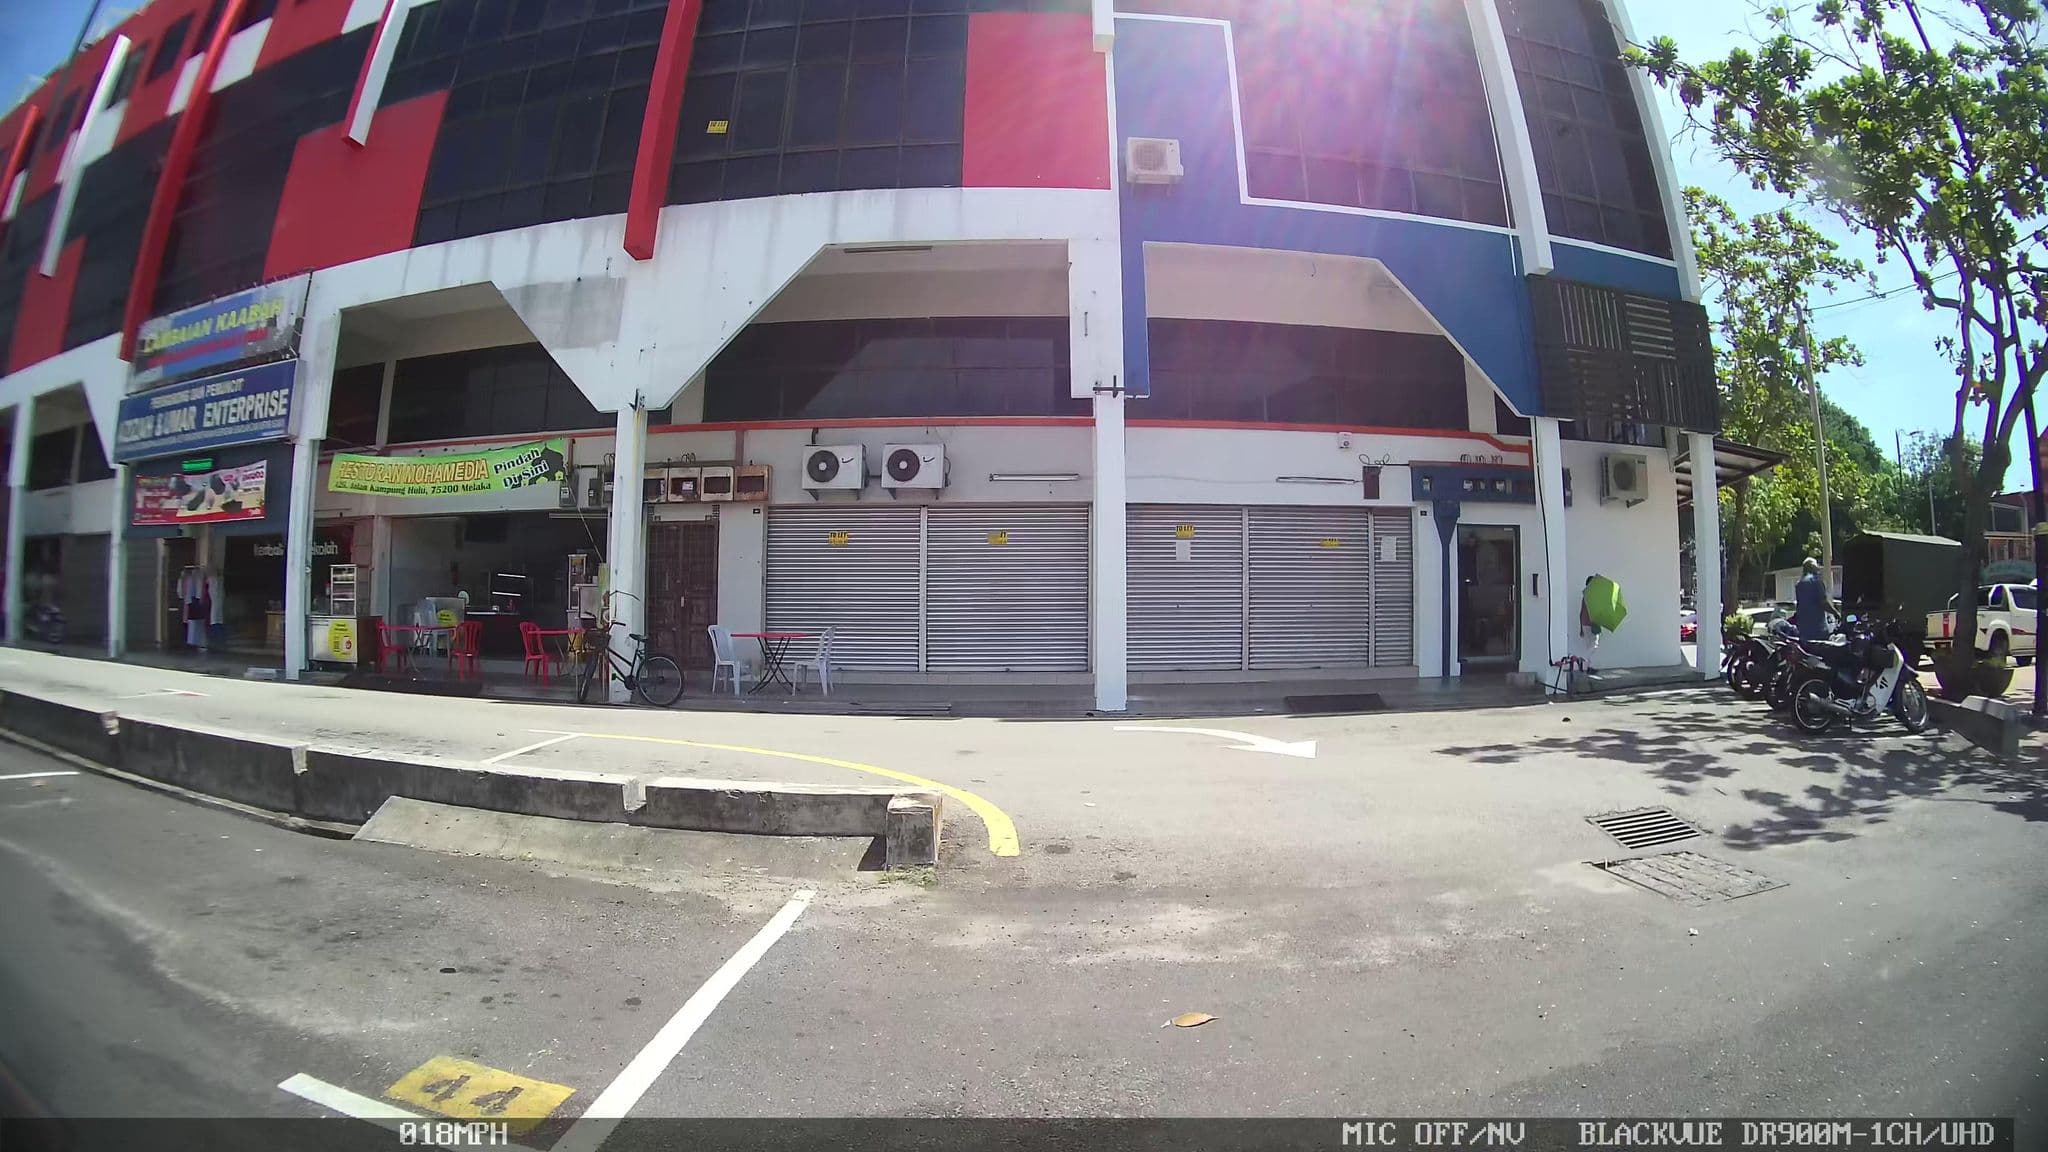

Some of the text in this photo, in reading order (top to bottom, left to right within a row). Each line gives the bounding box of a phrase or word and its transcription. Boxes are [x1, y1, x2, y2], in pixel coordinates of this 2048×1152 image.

[163, 405, 197, 434] UMAR
[203, 388, 289, 428] ENTERPRISE
[339, 458, 489, 484] RESTORAN MOHAMEDIA
[494, 448, 541, 474] Pindah
[503, 460, 549, 487] Di Sini
[350, 481, 368, 491] Jalan
[369, 482, 406, 495] Kampung
[431, 484, 459, 494] 75200
[461, 482, 492, 493] Melaka
